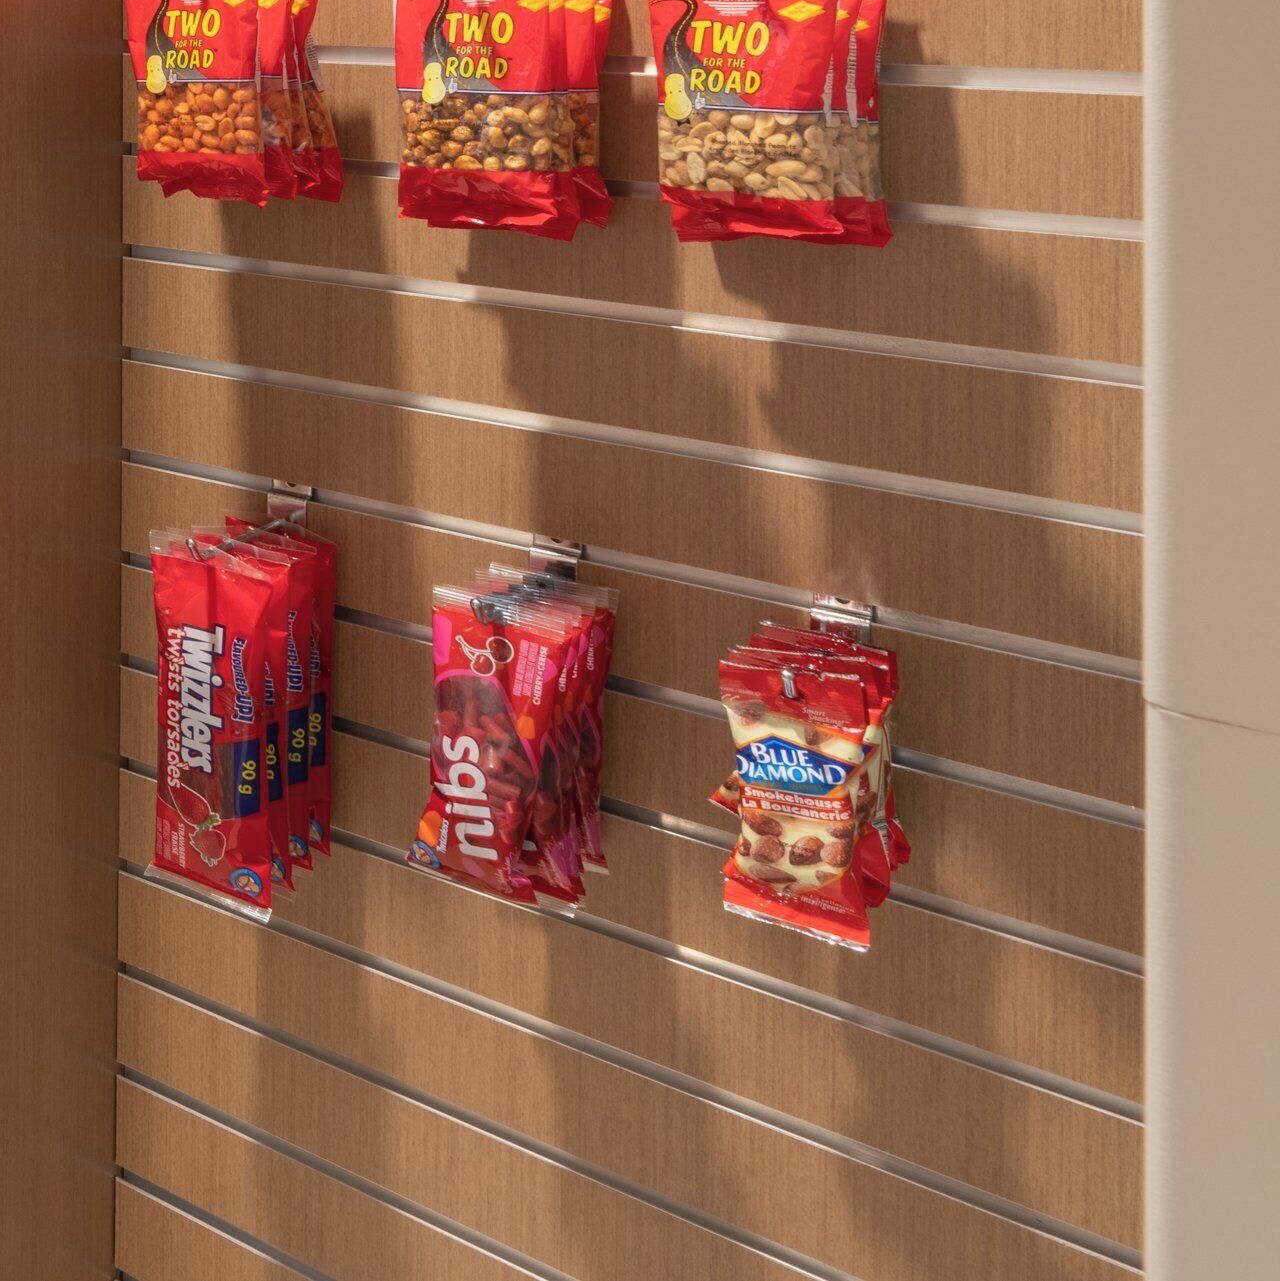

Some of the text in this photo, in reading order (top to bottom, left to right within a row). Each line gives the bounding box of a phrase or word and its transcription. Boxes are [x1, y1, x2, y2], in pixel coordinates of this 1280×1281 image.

[165, 7, 221, 39] TWO
[444, 11, 515, 45] TWO
[174, 39, 203, 49] FOR THE
[455, 45, 494, 55] FOR THE
[690, 19, 771, 57] TWO
[165, 49, 215, 70] ROAD
[445, 56, 509, 79] ROAD
[702, 57, 746, 69] FOR THE
[690, 68, 761, 95] ROAD
[180, 623, 226, 776] Twizzlers
[750, 742, 815, 767] BLUE
[238, 760, 257, 795] 90 g
[735, 754, 848, 786] DIAMOND
[433, 734, 499, 861] nibs
[741, 797, 850, 821] La Boucanerie
[743, 786, 842, 810] Smokehouse
